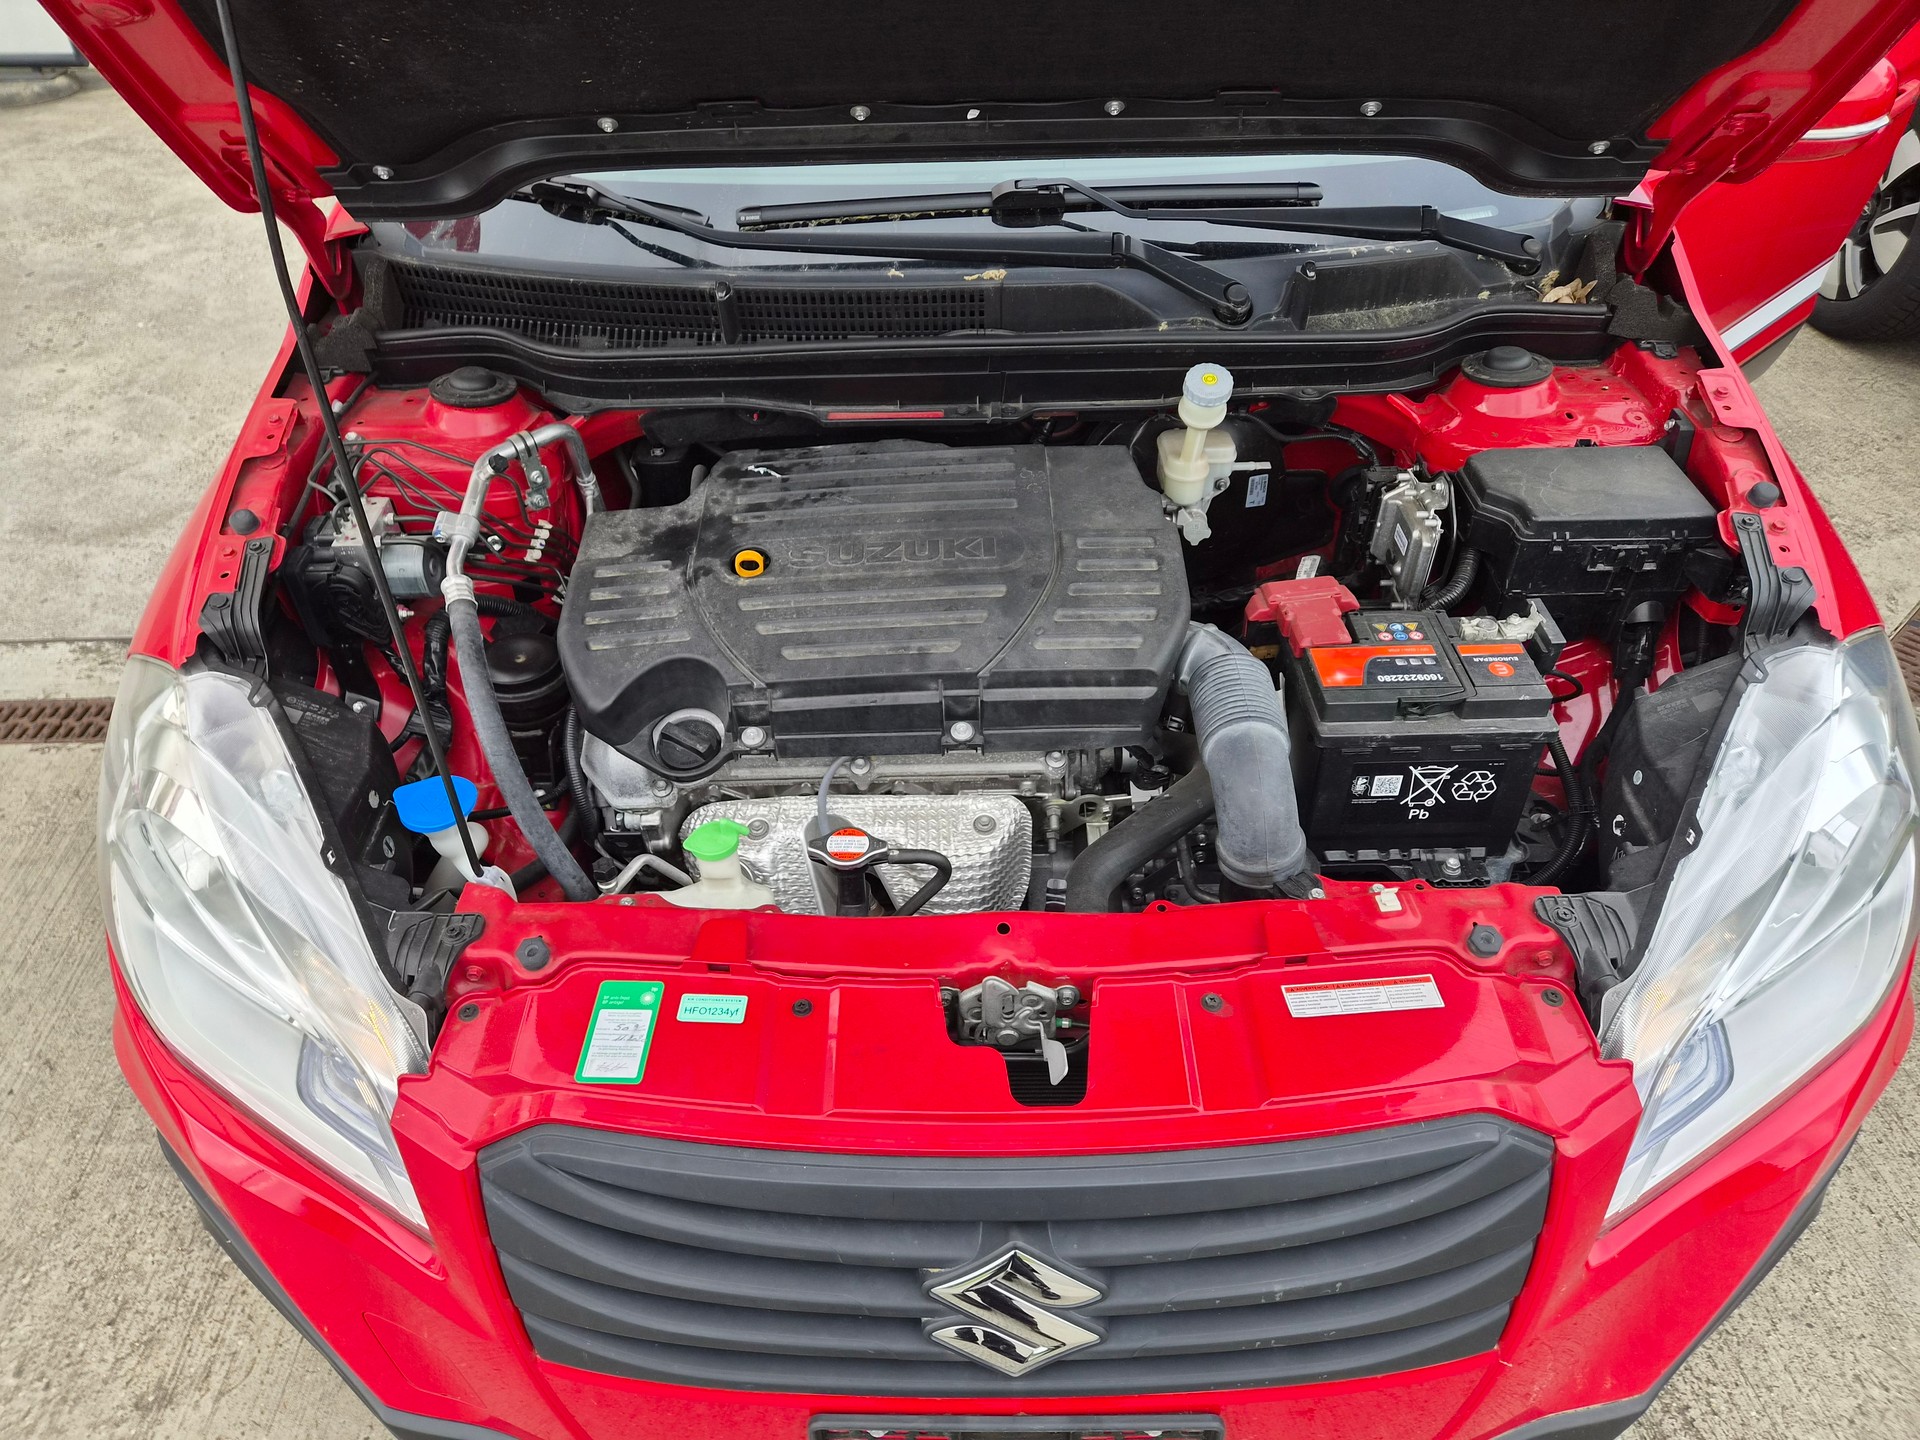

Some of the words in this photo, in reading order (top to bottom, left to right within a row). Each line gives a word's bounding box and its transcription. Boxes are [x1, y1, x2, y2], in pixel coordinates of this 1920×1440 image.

[788, 536, 998, 569] SUZUKI
[1377, 673, 1444, 683] 1609232280
[1408, 808, 1430, 820] Pb
[683, 1006, 740, 1018] HFO1234yf
